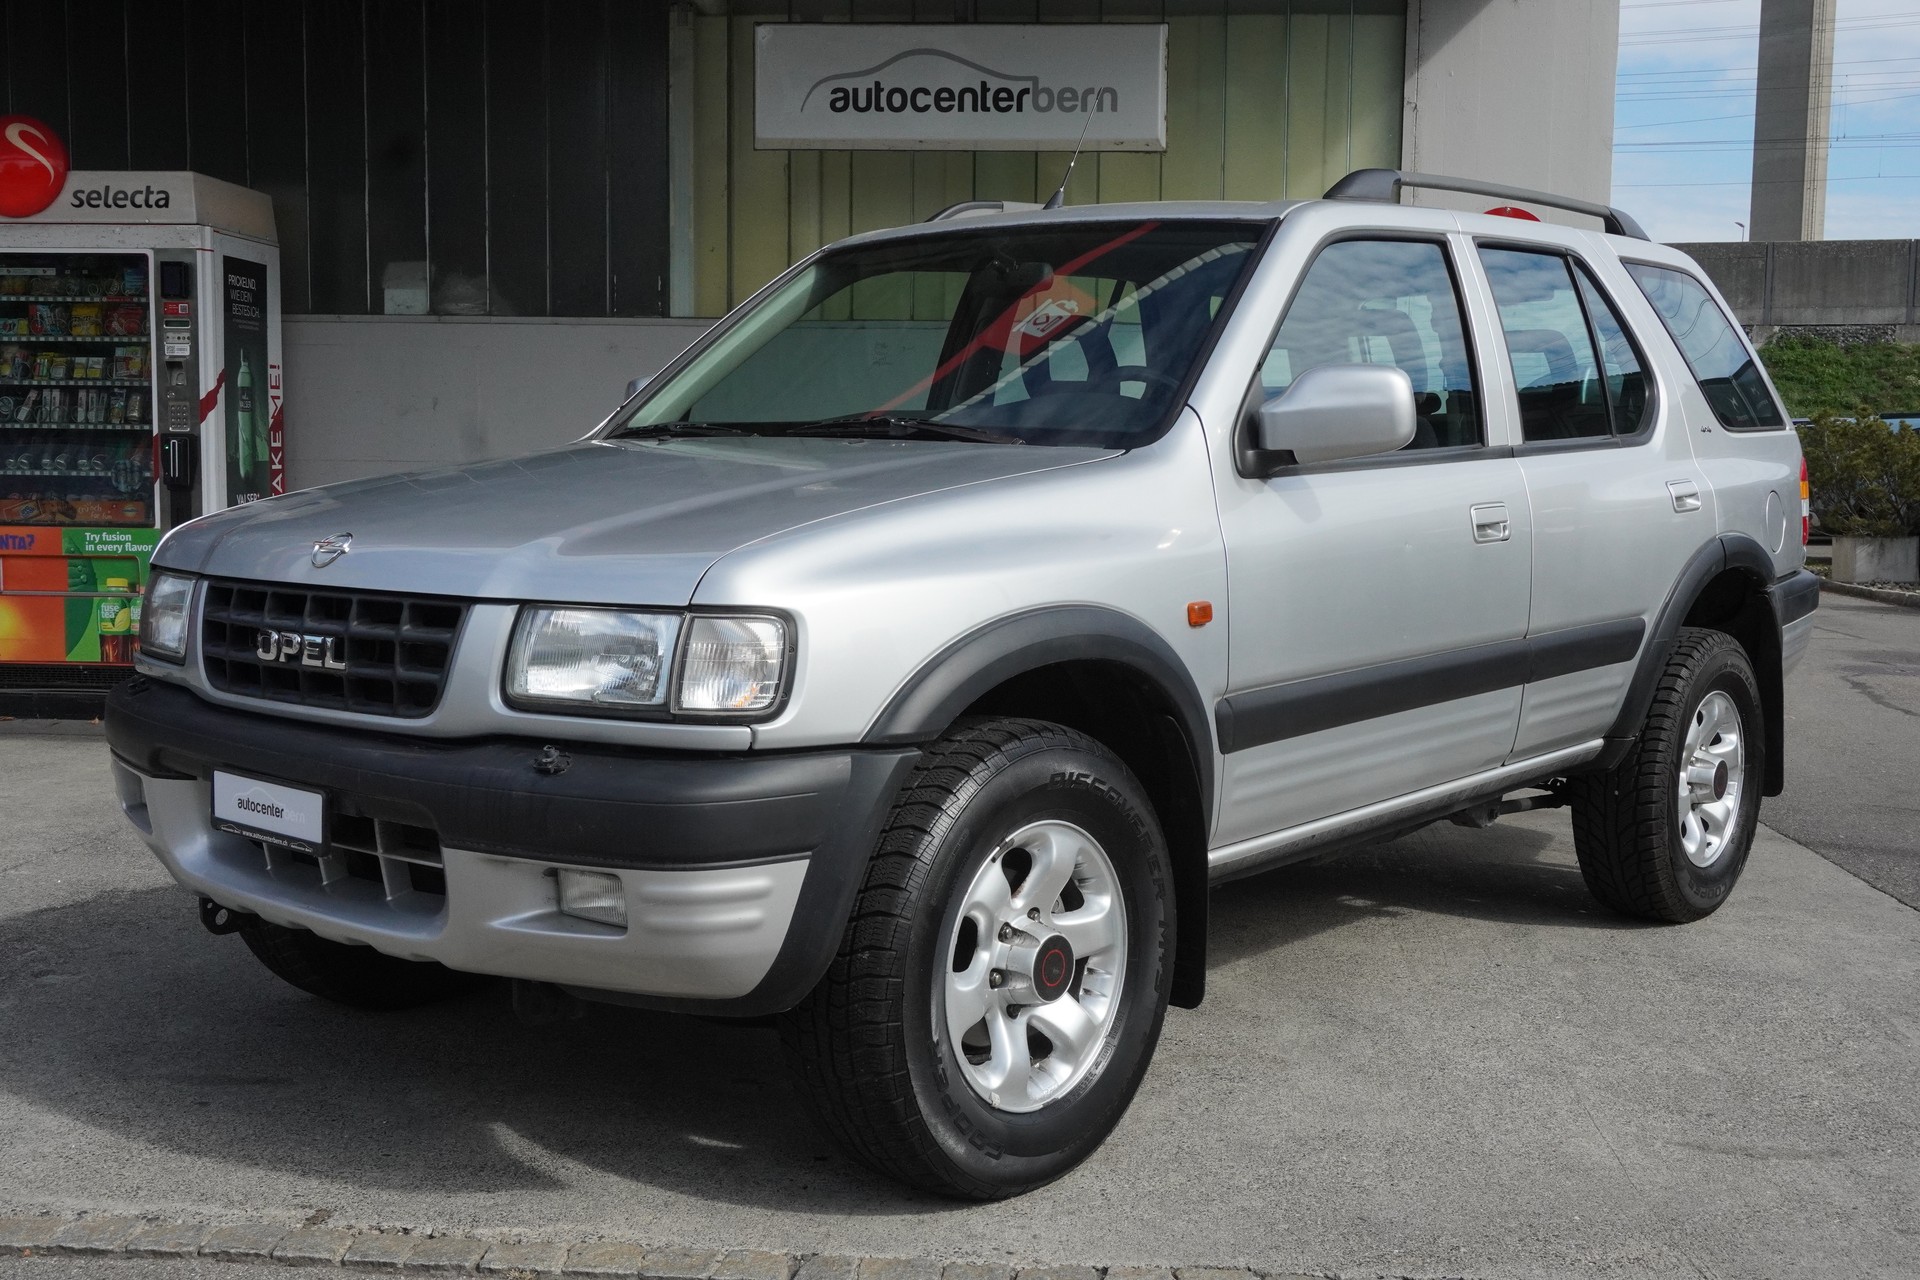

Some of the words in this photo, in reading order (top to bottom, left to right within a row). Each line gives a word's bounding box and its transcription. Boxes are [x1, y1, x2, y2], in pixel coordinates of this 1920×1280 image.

[829, 78, 1119, 113] autocenterbern
[70, 185, 170, 209] selecta
[84, 532, 100, 543] Try
[102, 532, 132, 542] fusion
[85, 542, 93, 552] in
[94, 543, 123, 554] every
[124, 541, 153, 552] flavor
[101, 602, 120, 612] fuse
[101, 611, 115, 619] tea
[256, 629, 346, 670] OPEL
